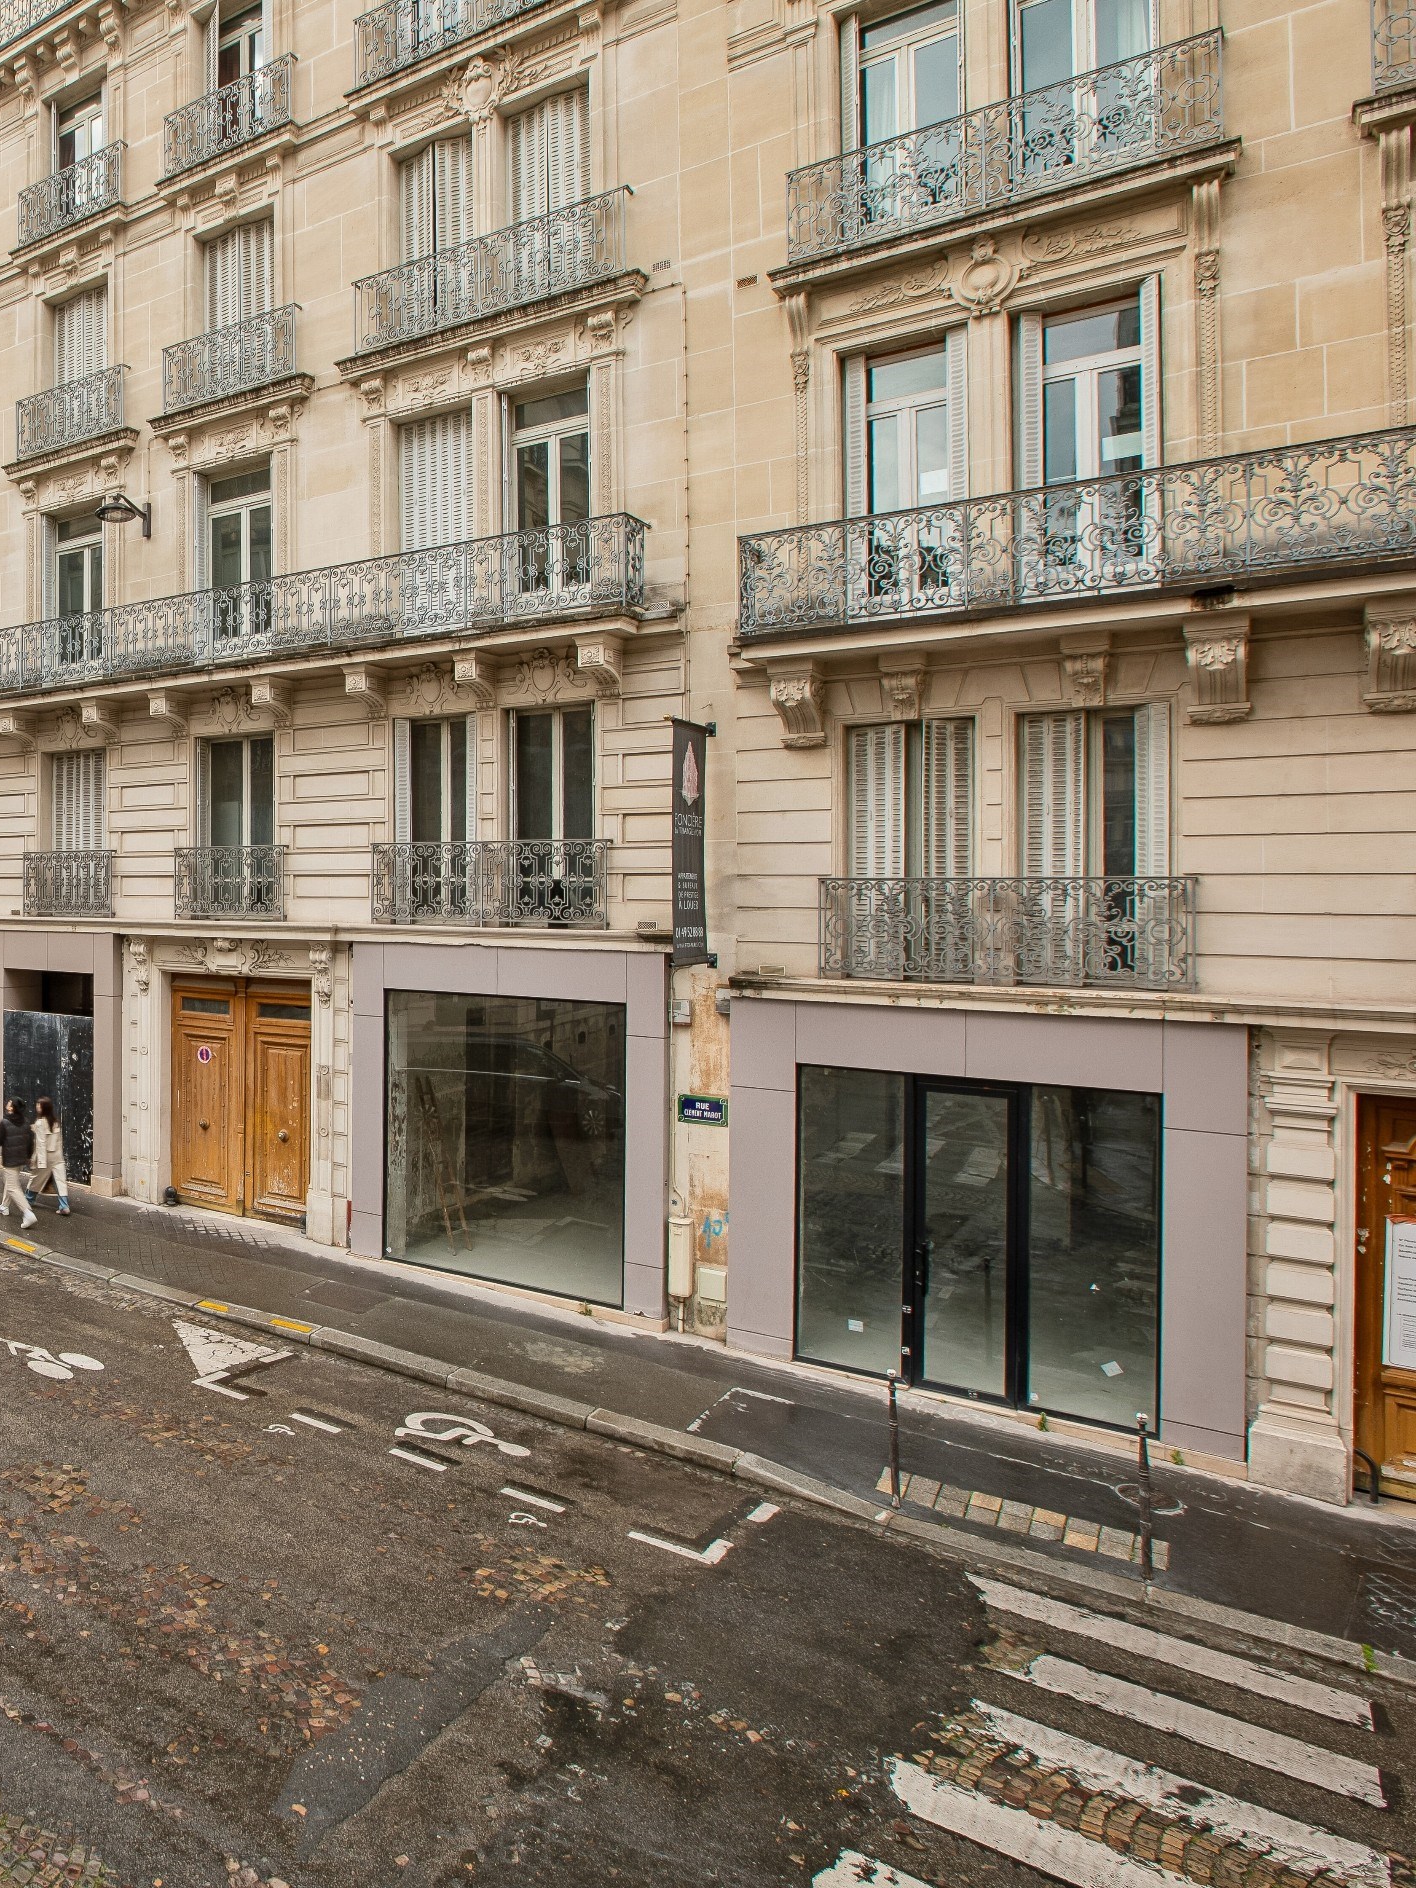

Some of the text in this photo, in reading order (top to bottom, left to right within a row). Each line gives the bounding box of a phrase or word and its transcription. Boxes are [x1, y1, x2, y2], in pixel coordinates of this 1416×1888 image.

[675, 812, 702, 828] FONCIÈRE
[684, 900, 698, 910] LOUER
[695, 1102, 710, 1110] RUE
[684, 1108, 722, 1119] CLÉMENT MAROT
